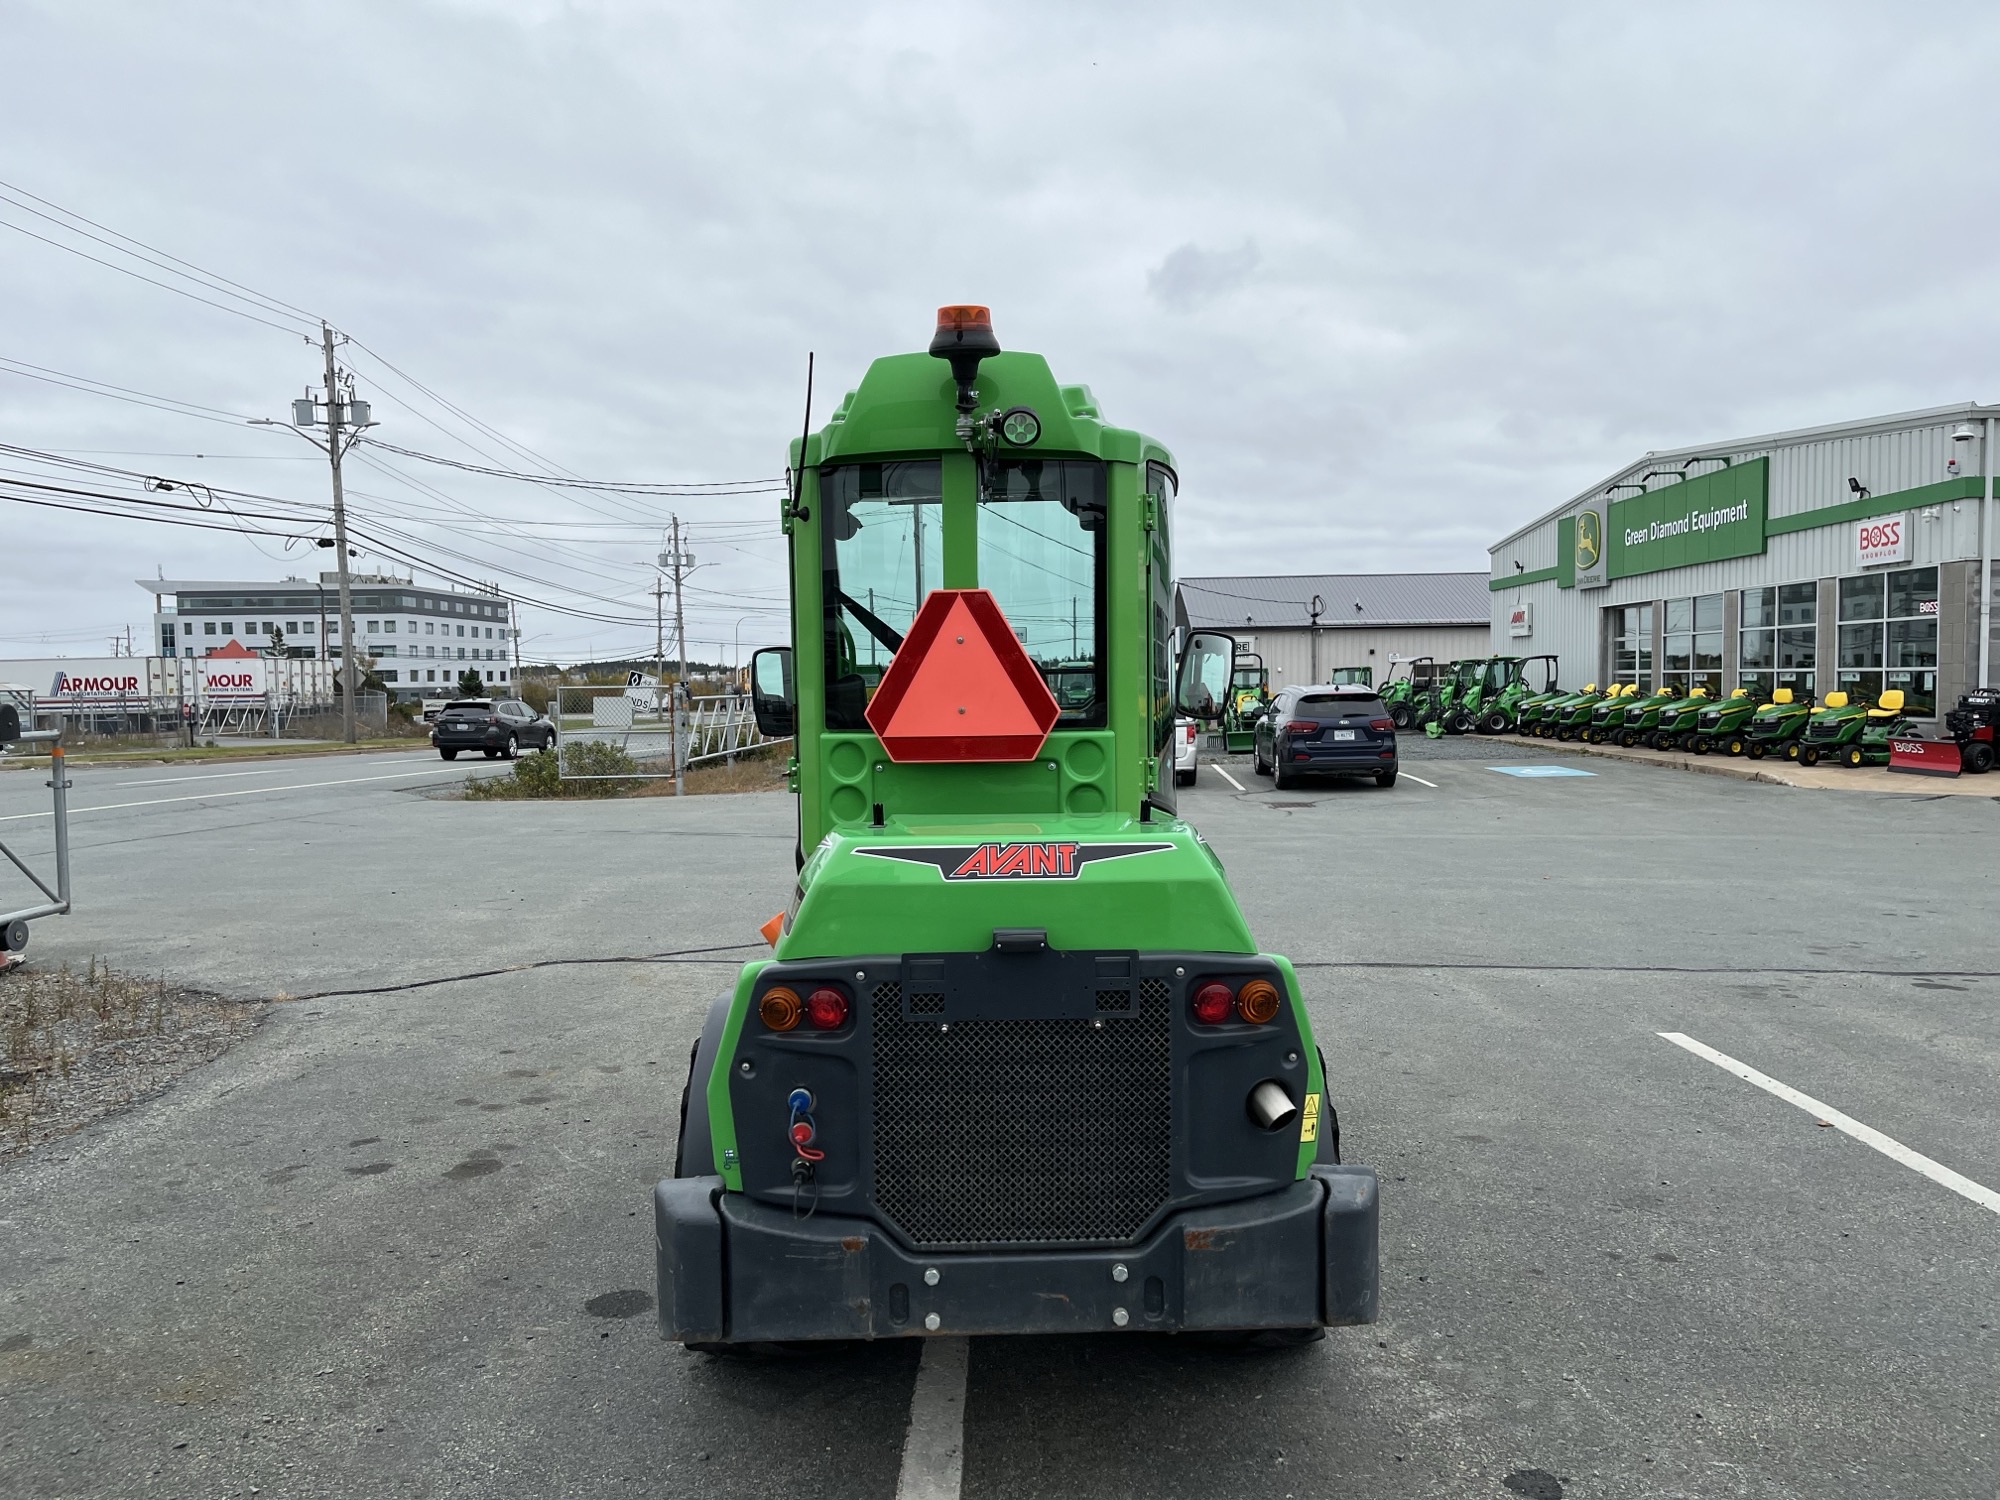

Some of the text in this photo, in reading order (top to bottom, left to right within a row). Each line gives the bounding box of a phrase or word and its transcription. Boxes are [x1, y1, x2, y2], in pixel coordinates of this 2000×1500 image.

[1624, 499, 1748, 547] Green Diamond Equipment
[1860, 522, 1900, 550] BOSS
[59, 674, 138, 692] ARMOUR
[631, 696, 649, 709] NDS
[1893, 742, 1924, 753] BOSS
[949, 843, 1077, 877] AVANT
